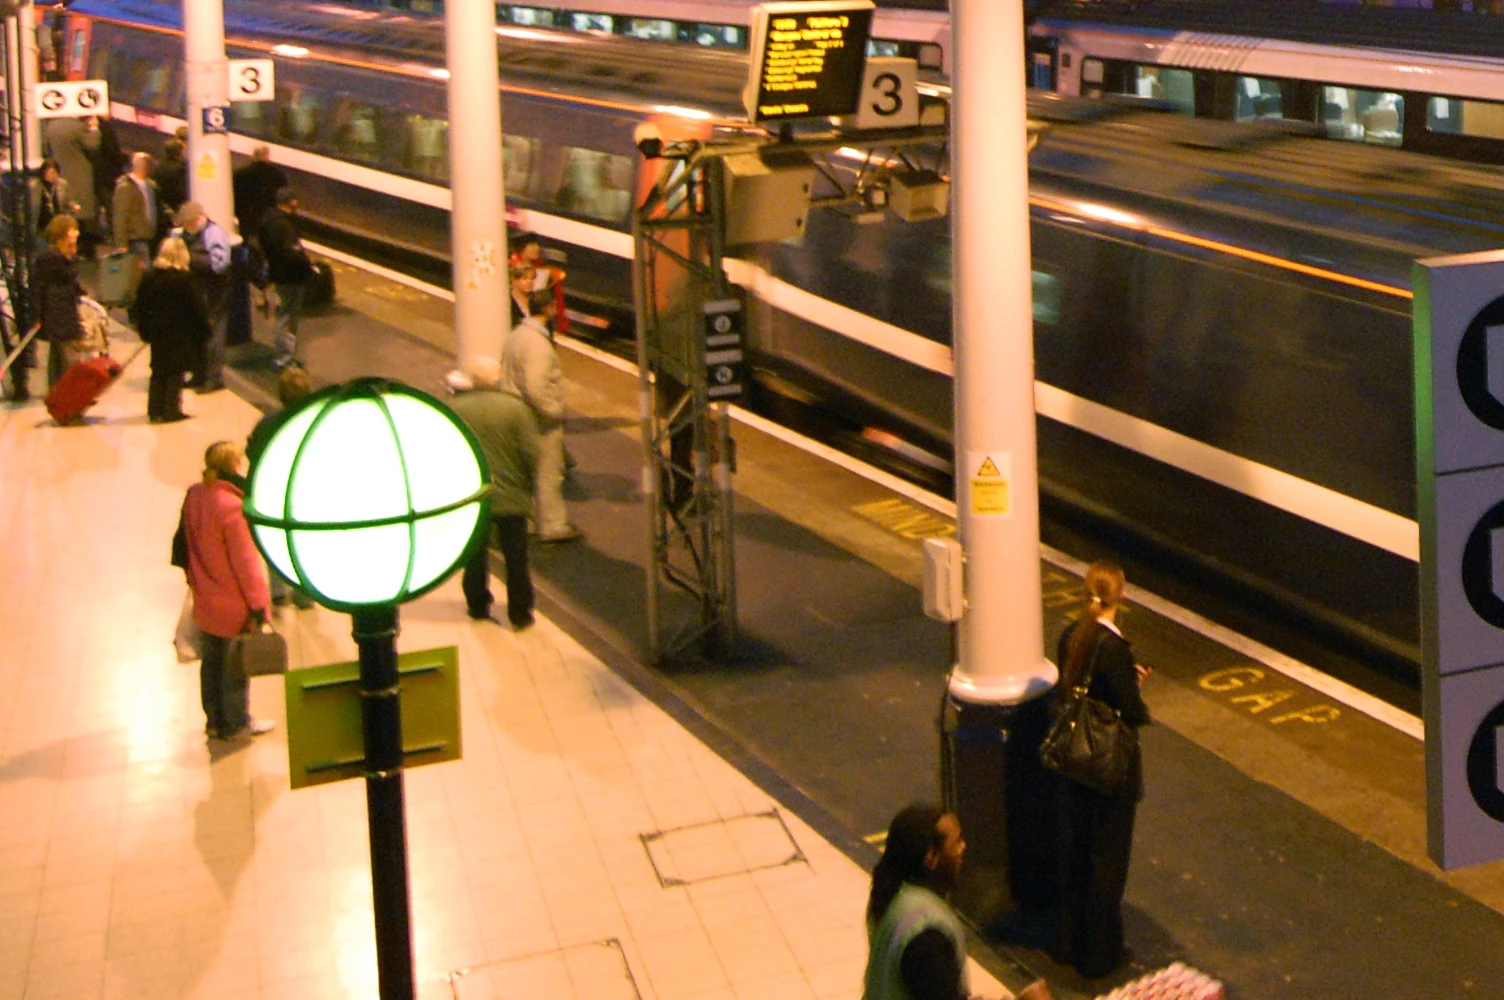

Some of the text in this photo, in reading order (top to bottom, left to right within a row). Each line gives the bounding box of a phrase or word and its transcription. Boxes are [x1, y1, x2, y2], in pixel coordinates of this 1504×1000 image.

[241, 67, 261, 94] 3
[871, 72, 903, 116] 3
[1198, 666, 1342, 725] GAP
